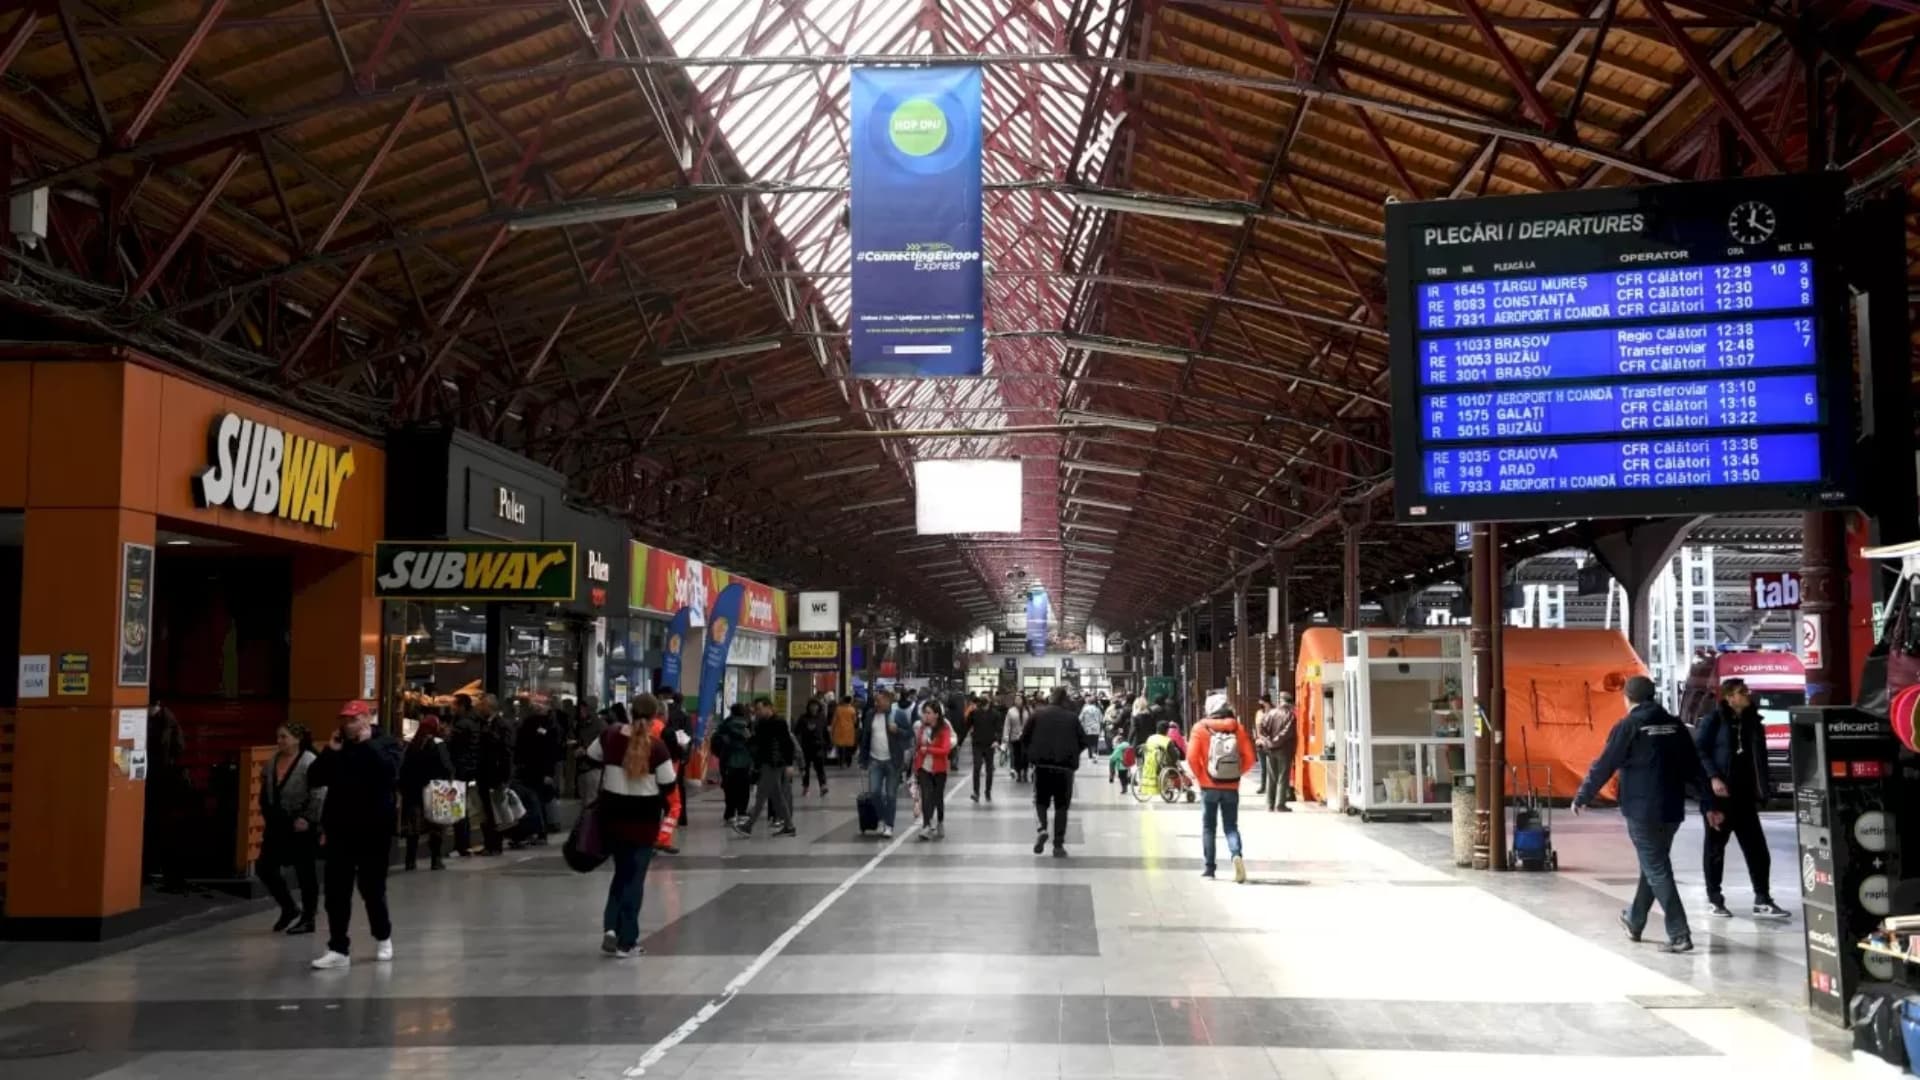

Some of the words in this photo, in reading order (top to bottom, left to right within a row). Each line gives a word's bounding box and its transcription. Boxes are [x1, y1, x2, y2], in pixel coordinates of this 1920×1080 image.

[1425, 222, 1504, 246] PLECĂRI
[1508, 223, 1514, 241] /
[1518, 213, 1645, 240] DEPARTURES
[857, 250, 980, 262] #ConnectingEurope
[914, 260, 961, 271] Express
[1619, 250, 1689, 263] OPERATOR
[1427, 286, 1440, 297] IR
[1453, 283, 1485, 296] 1645
[1616, 273, 1643, 286] CFR
[1715, 265, 1752, 279] 12:29
[1770, 263, 1785, 276] 10
[1800, 262, 1808, 274] 3
[1428, 301, 1444, 312] RE
[1616, 288, 1644, 301] CFR
[1715, 280, 1752, 294] 12:30
[1800, 277, 1809, 289] 9
[1429, 315, 1445, 328] RE
[1454, 313, 1486, 326] 7931
[1494, 309, 1549, 325] AEROPORT
[1554, 308, 1562, 321] H
[1617, 303, 1644, 317] CFR
[1716, 296, 1753, 310] 12:30
[1801, 292, 1809, 304] 8
[1429, 341, 1438, 353] R
[1454, 338, 1491, 352] 11033
[1618, 330, 1653, 345] Regio
[1716, 323, 1753, 337] 12:38
[1794, 319, 1810, 333] 12
[1430, 356, 1446, 368] RE
[1455, 353, 1492, 367] 10053
[1494, 350, 1540, 365] BUZĂU
[1619, 341, 1707, 357] Transferoviar
[1717, 338, 1755, 352] 12:48
[1802, 335, 1811, 348] 7
[1430, 370, 1447, 383] RE
[1455, 368, 1487, 382] 3001
[1619, 360, 1646, 373] CFR
[1718, 353, 1755, 367] 13:07
[1431, 397, 1447, 409] RE
[1456, 394, 1492, 407] 10107
[1496, 391, 1552, 405] AEROPORT
[1556, 390, 1564, 402] H
[1620, 383, 1709, 400] Transferoviar
[1719, 380, 1756, 394] 13:10
[1431, 411, 1444, 423] IR
[1457, 409, 1489, 422] 1575
[1621, 401, 1648, 414] CFR
[1720, 395, 1757, 409] 13:16
[1805, 392, 1814, 405] 6
[1432, 426, 1441, 438] R
[1457, 424, 1490, 437] 5015
[1497, 421, 1542, 436] BUZĂU
[1621, 416, 1648, 430] CFR
[1720, 411, 1757, 425] 13:22
[1433, 452, 1449, 464] RE
[1458, 450, 1491, 463] 9035
[1498, 447, 1558, 462] CRAIOVA
[1622, 442, 1649, 456] CFR
[1721, 438, 1758, 451] 13:36
[202, 412, 356, 529] SUBWAY
[1433, 467, 1445, 479] IR
[1459, 465, 1483, 478] 349
[1499, 463, 1535, 476] ARAD
[1623, 458, 1650, 471] CFR
[1722, 453, 1759, 467] 13:45
[1434, 481, 1451, 494] RE
[1460, 480, 1492, 493] 7933
[1499, 477, 1555, 492] AEROPORT
[1560, 476, 1567, 488] H
[1624, 473, 1650, 486] CFR
[1723, 469, 1760, 482] 13:50
[499, 487, 525, 524] Polen
[377, 549, 567, 590] SUBWAY
[811, 603, 828, 612] WC
[24, 663, 47, 672] FREE
[25, 679, 43, 688] SIM
